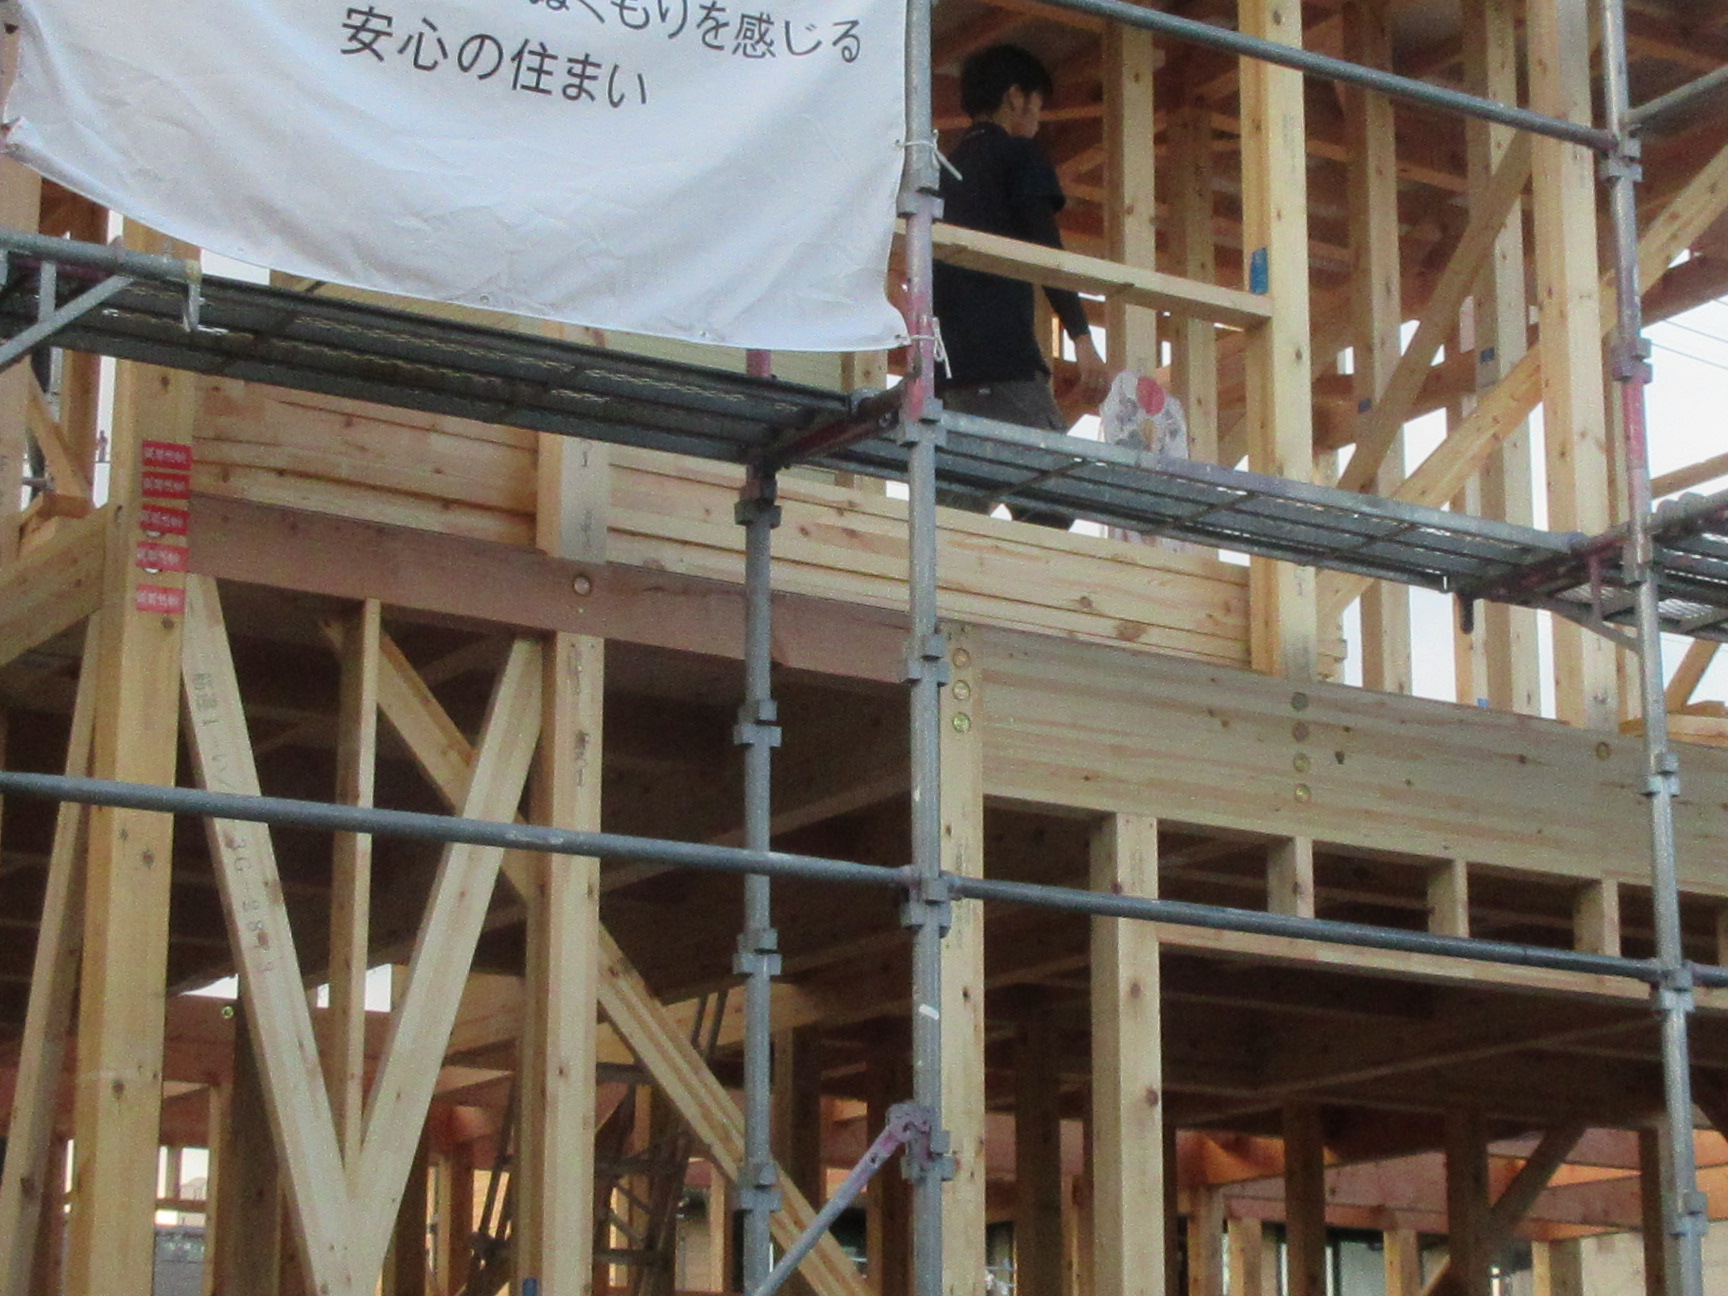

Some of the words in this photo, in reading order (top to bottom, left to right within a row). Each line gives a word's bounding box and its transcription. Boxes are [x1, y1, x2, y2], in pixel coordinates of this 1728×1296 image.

[339, 4, 649, 108] 安心の住まい
